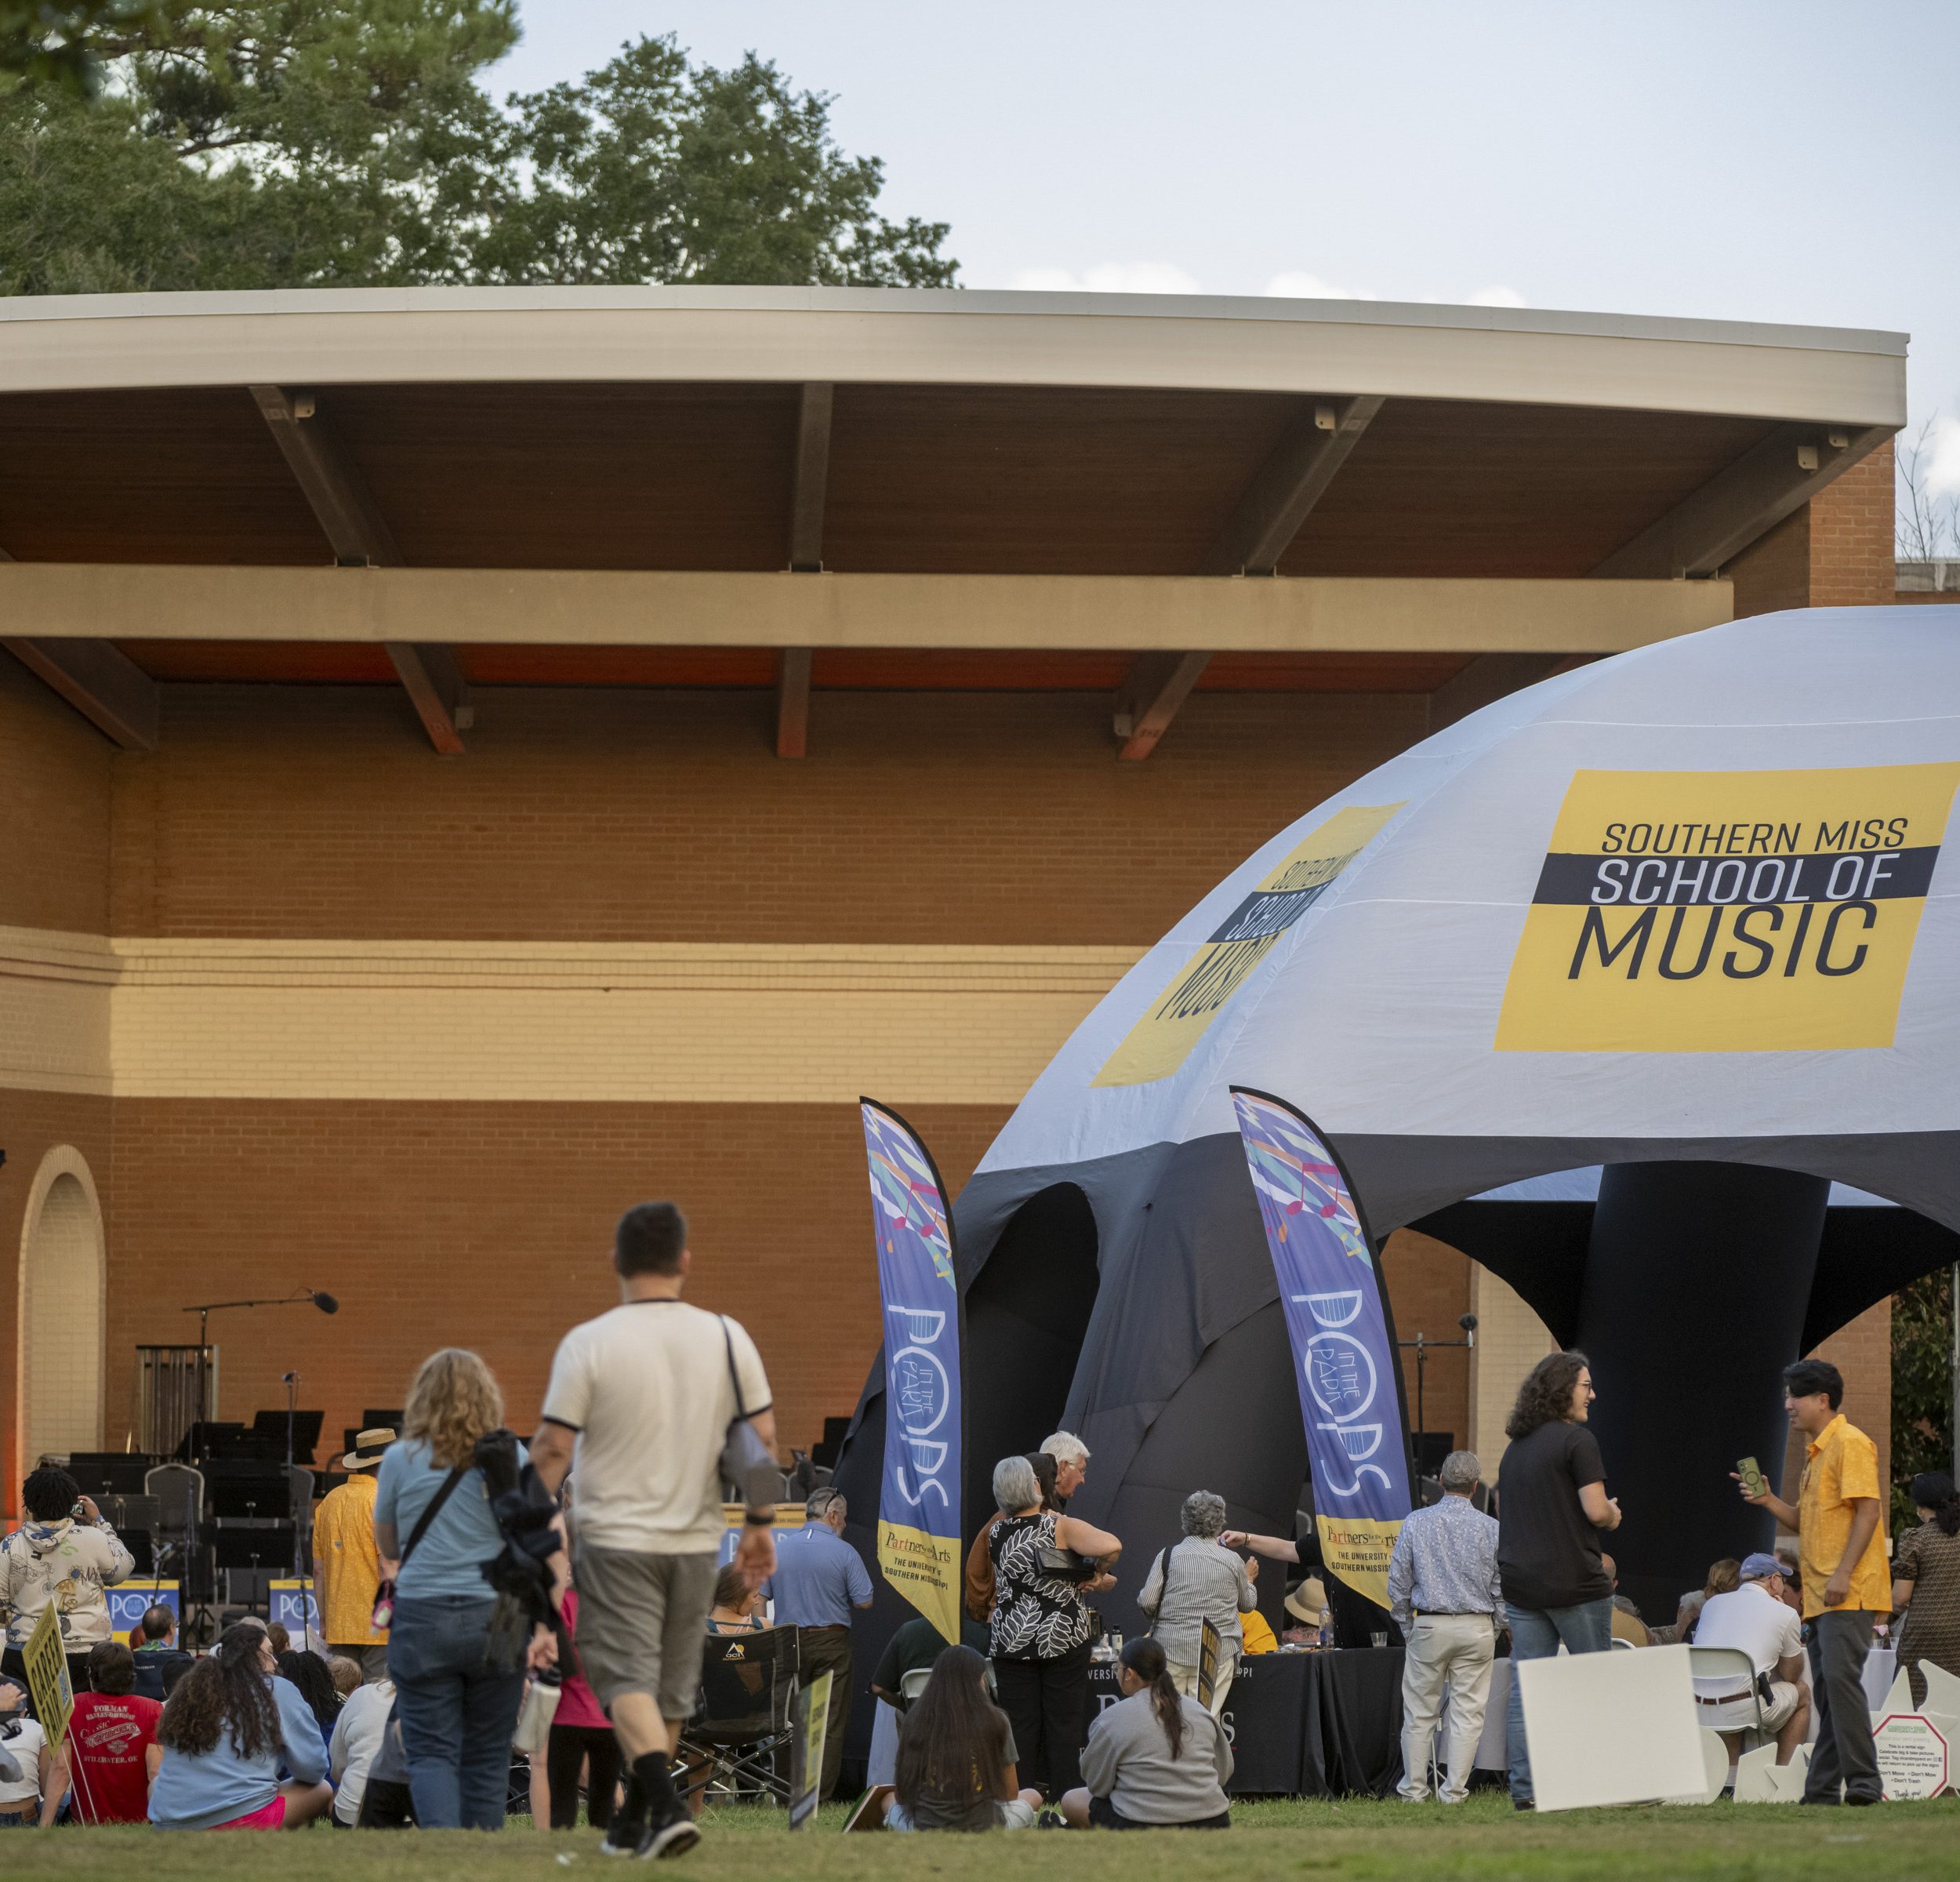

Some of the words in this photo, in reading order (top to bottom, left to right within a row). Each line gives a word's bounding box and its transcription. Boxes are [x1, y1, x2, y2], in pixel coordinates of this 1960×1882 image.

[1601, 823, 1801, 854] SOUTHERN
[1814, 818, 1908, 852] MISS
[1591, 859, 1809, 903] SCHOOL
[1825, 853, 1900, 899] OF
[1568, 900, 1878, 979] MUSIC
[920, 1368, 933, 1384] IN
[1312, 1348, 1344, 1404] PARK
[1338, 1352, 1355, 1369] IN
[902, 1361, 924, 1418] PARK
[1291, 1290, 1392, 1496] POPS
[1341, 1372, 1360, 1399] THE
[888, 1304, 949, 1506] POPS
[920, 1389, 934, 1415] THE
[885, 1531, 926, 1554] Partners
[931, 1544, 951, 1562] Arts
[1327, 1525, 1369, 1544] Partners
[1381, 1534, 1399, 1546] rts
[894, 1557, 906, 1567] THE
[908, 1560, 937, 1574] UNIERTY
[1331, 1561, 1365, 1571] SOUTHERN
[1338, 1551, 1349, 1560] THE
[1352, 1552, 1388, 1560] UNIVERSITY
[885, 1567, 920, 1581] SOUTHERN
[31, 1628, 63, 1706] CAREER
[42, 1687, 64, 1747] FAIR
